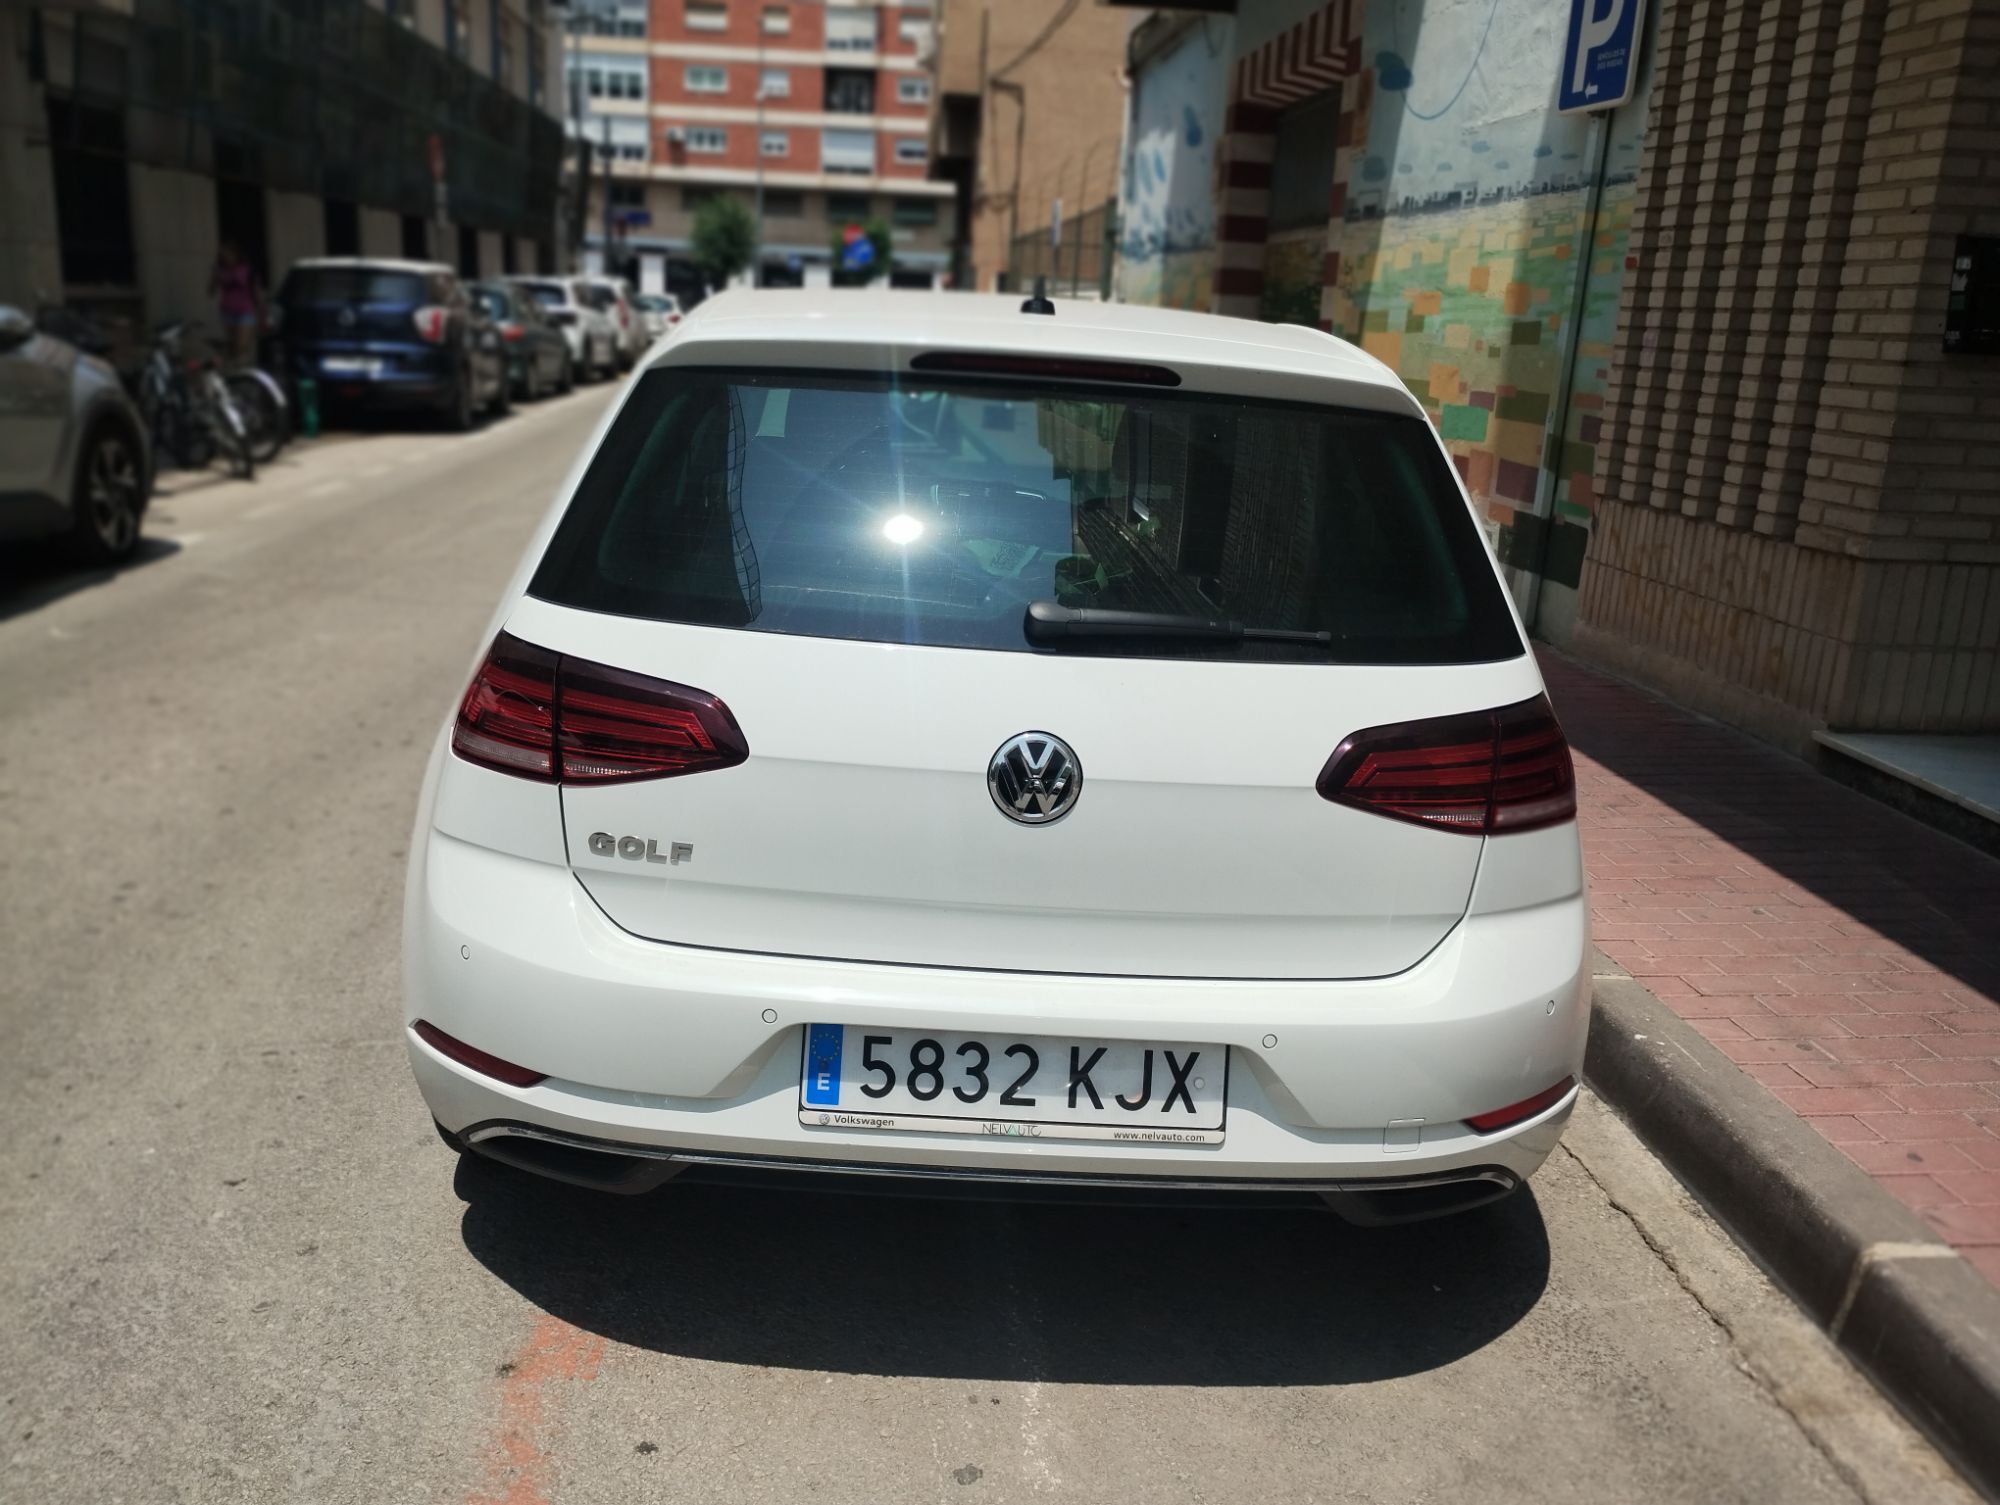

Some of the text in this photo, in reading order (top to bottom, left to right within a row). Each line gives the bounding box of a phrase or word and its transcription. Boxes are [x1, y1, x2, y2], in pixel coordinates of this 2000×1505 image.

[1572, 0, 1625, 93] P
[587, 831, 694, 866] GOLF
[816, 1072, 830, 1092] E
[859, 1034, 1201, 1114] 5832 KJX
[833, 1114, 895, 1128] Volkswagen
[1113, 1130, 1205, 1143] www.nelvauto.com
